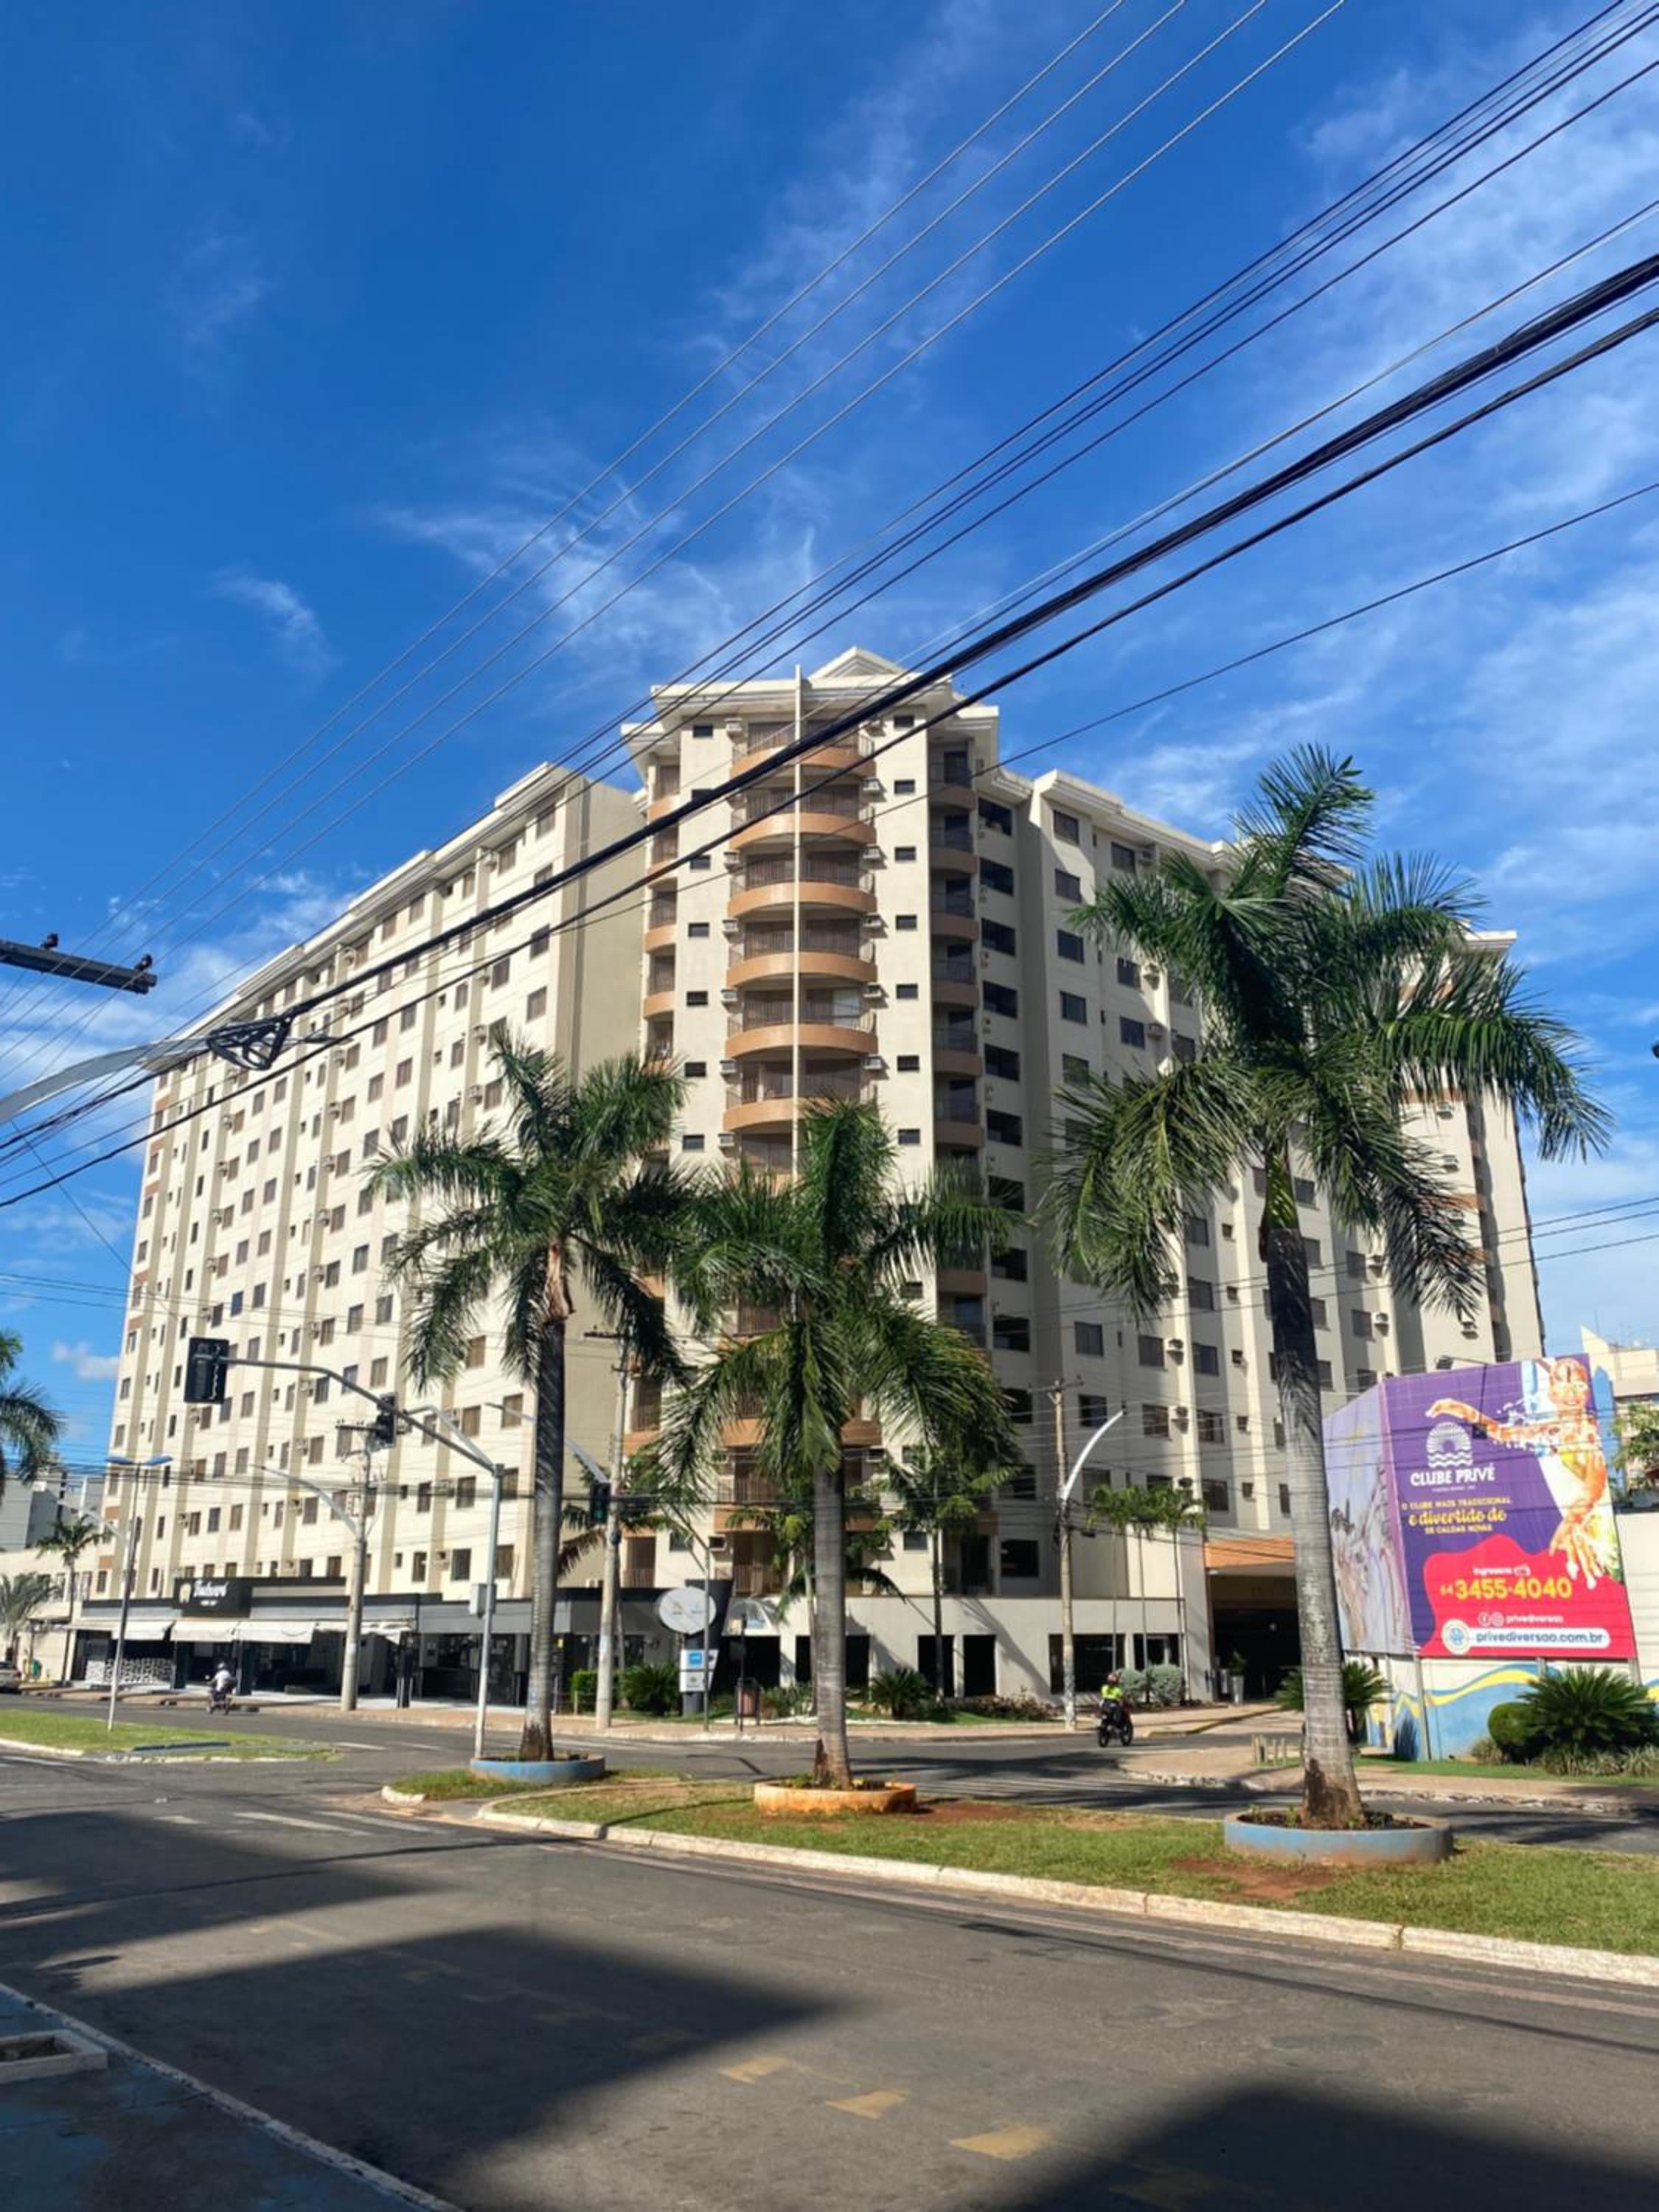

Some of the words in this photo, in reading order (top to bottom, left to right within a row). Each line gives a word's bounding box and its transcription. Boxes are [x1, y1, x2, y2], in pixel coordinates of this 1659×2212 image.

[1410, 1470, 1452, 1486] CLUBE
[1455, 1462, 1495, 1484] PRIVÉ
[1402, 1502, 1408, 1510] O
[1410, 1500, 1433, 1510] CLUBE
[1419, 1508, 1485, 1526] divertido
[1454, 1577, 1573, 1600] 3455-4040
[1475, 1630, 1603, 1644] privediversao.com.br
